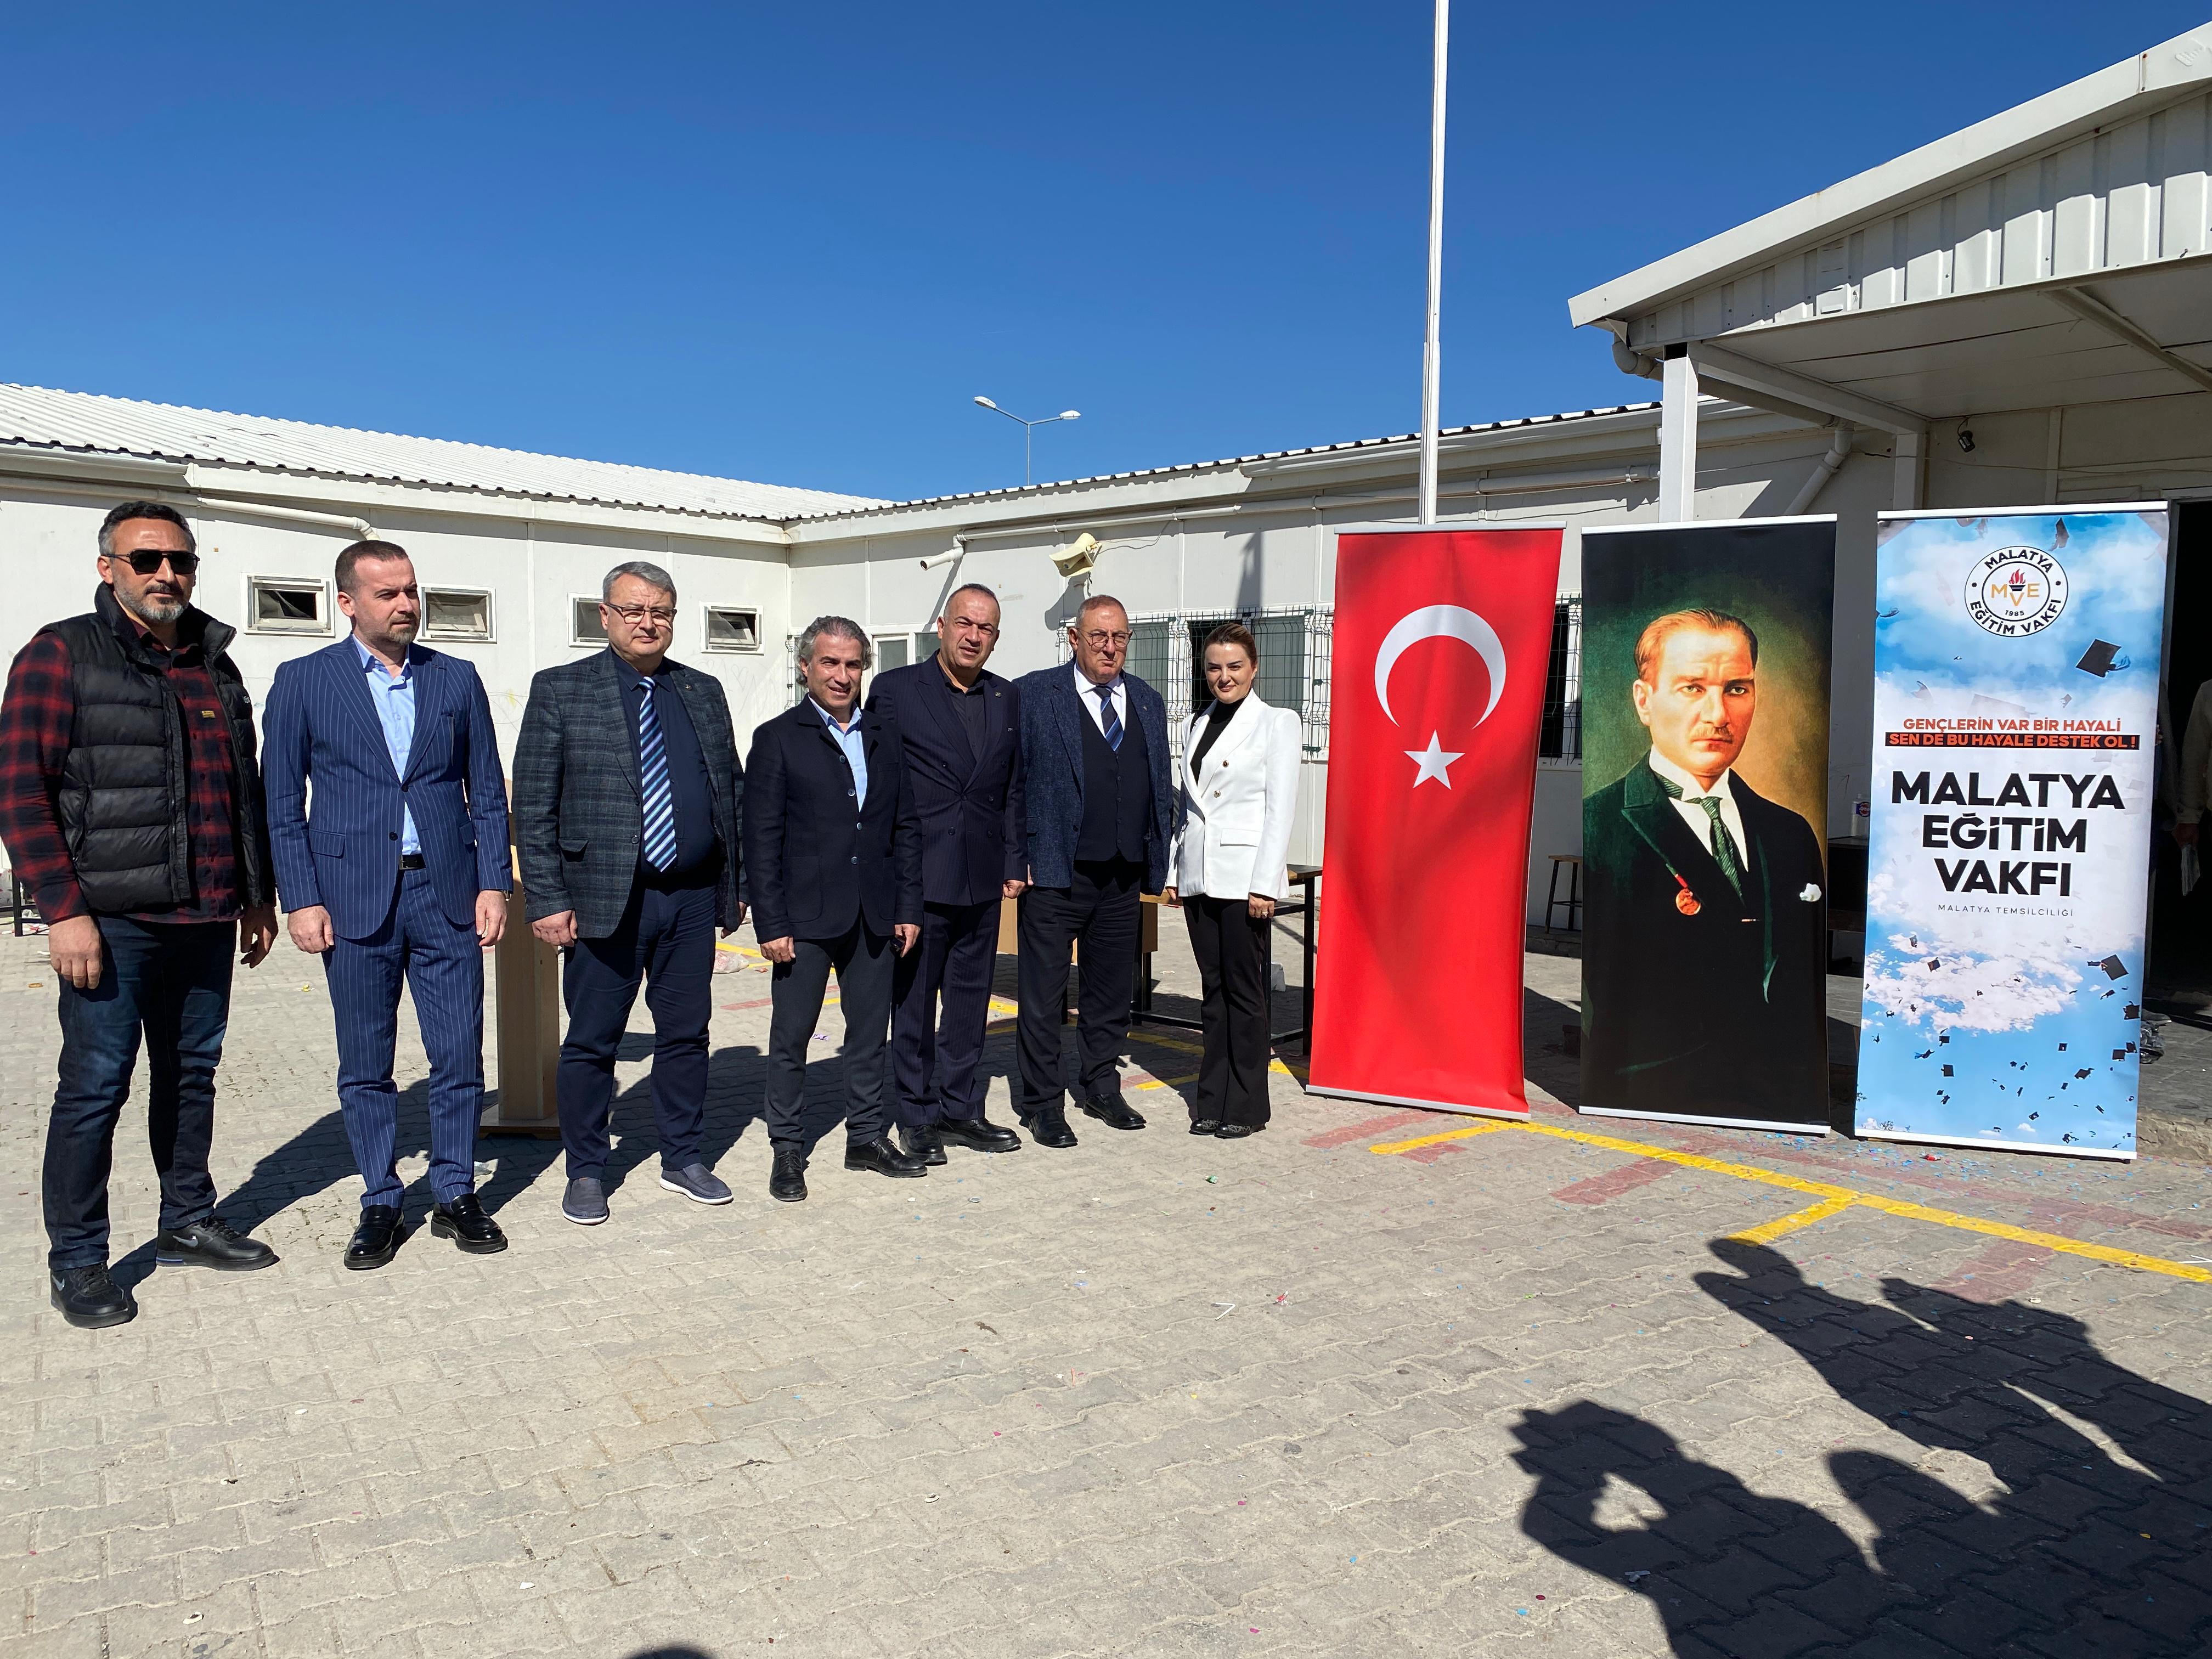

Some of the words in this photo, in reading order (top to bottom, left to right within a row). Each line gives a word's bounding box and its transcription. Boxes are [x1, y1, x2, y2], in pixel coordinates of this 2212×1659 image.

[1984, 549, 2053, 573] MALATYA
[1970, 601, 2015, 634] EĞİTİM
[2021, 599, 2061, 633] VAKFI
[1904, 716, 1993, 733] GENÇLERİN
[1997, 719, 2029, 730] VAR
[2034, 717, 2059, 731] BİR
[2063, 718, 2121, 731] HAYALİ
[1889, 733, 1920, 745] SEN
[1923, 733, 1943, 745] DE
[1948, 734, 1968, 746] BU
[1972, 734, 2033, 746] HAYALE
[2037, 735, 2101, 747] DESTEK
[1892, 771, 2126, 809] MALATYA
[1922, 812, 2087, 853] EĞİTİM
[1934, 858, 2072, 896] VAKFI
[1938, 904, 1990, 913] MALATYA
[1996, 907, 2073, 917] TEMSİLCİLİĞİ
